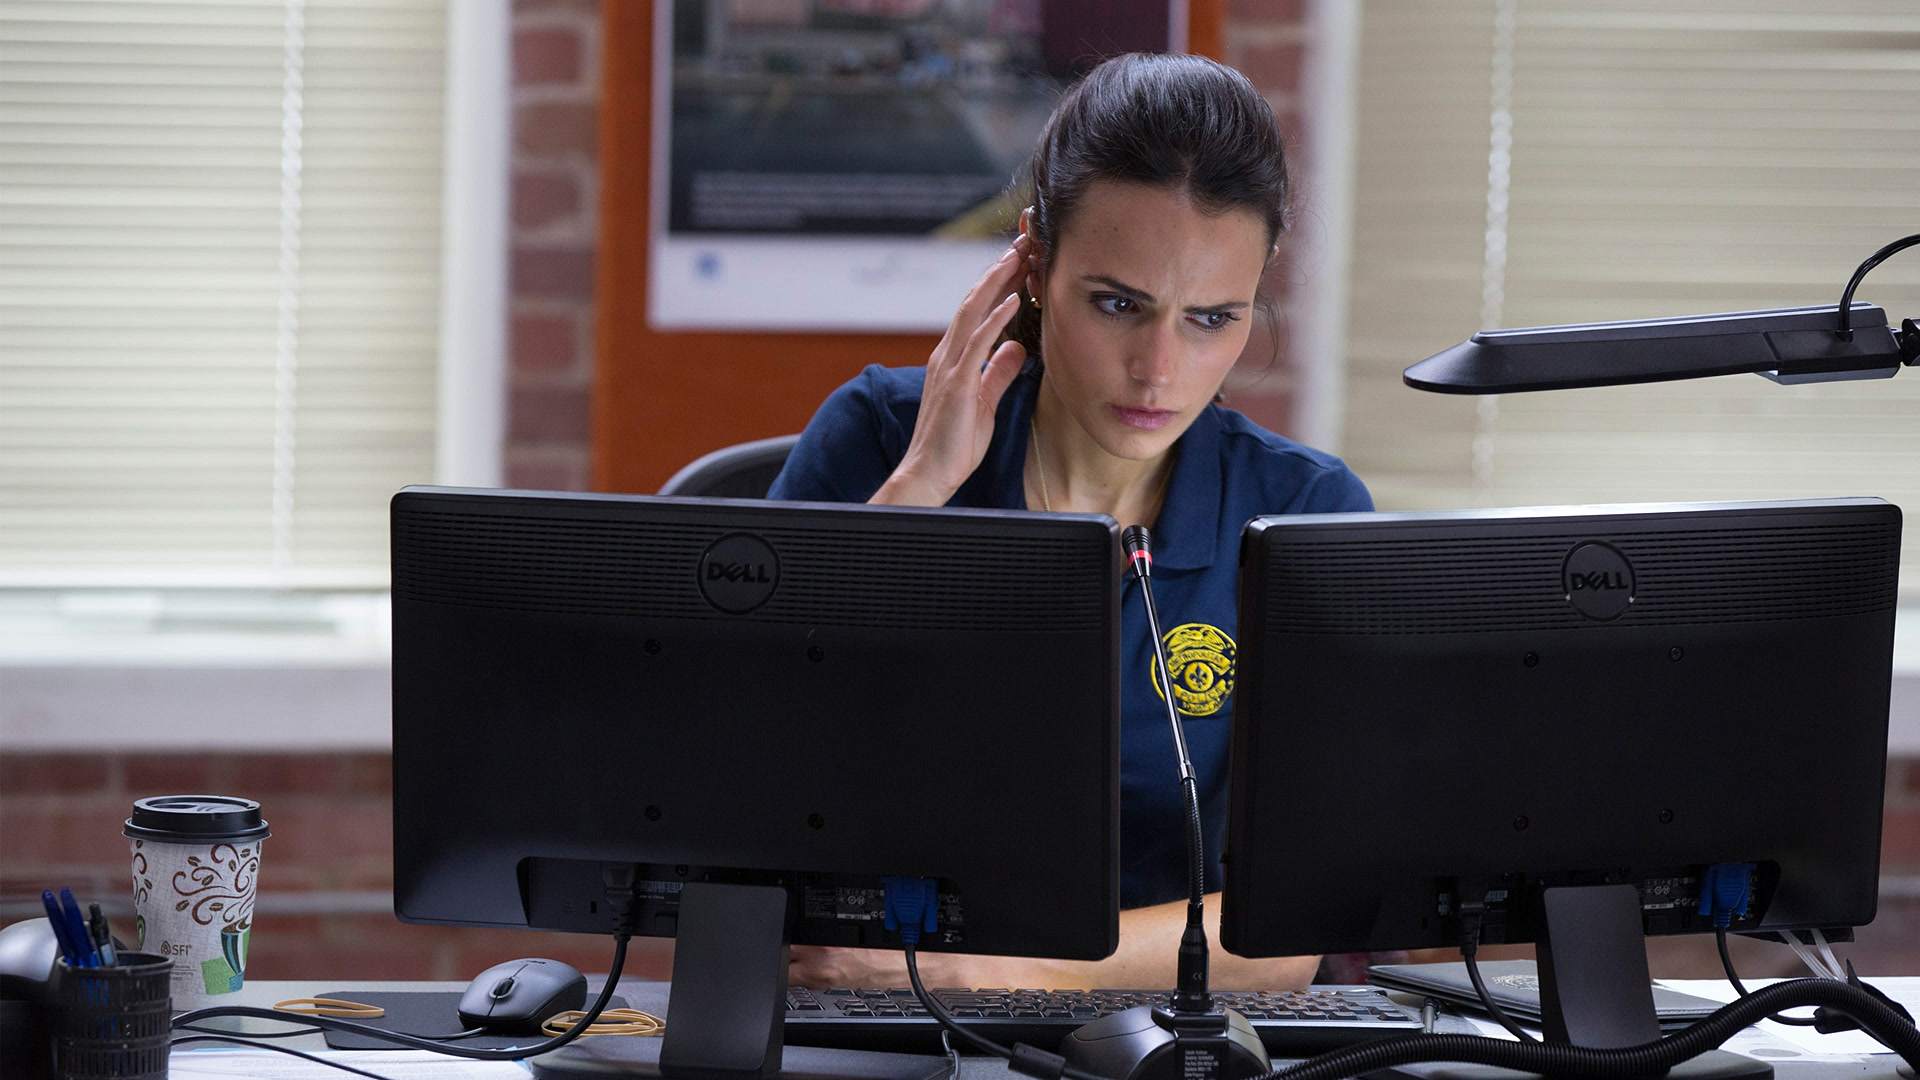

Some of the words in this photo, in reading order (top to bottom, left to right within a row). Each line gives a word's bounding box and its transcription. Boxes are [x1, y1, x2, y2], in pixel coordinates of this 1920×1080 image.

[707, 561, 770, 583] DELL
[1570, 571, 1629, 591] DELL
[1181, 686, 1222, 702] POLICE
